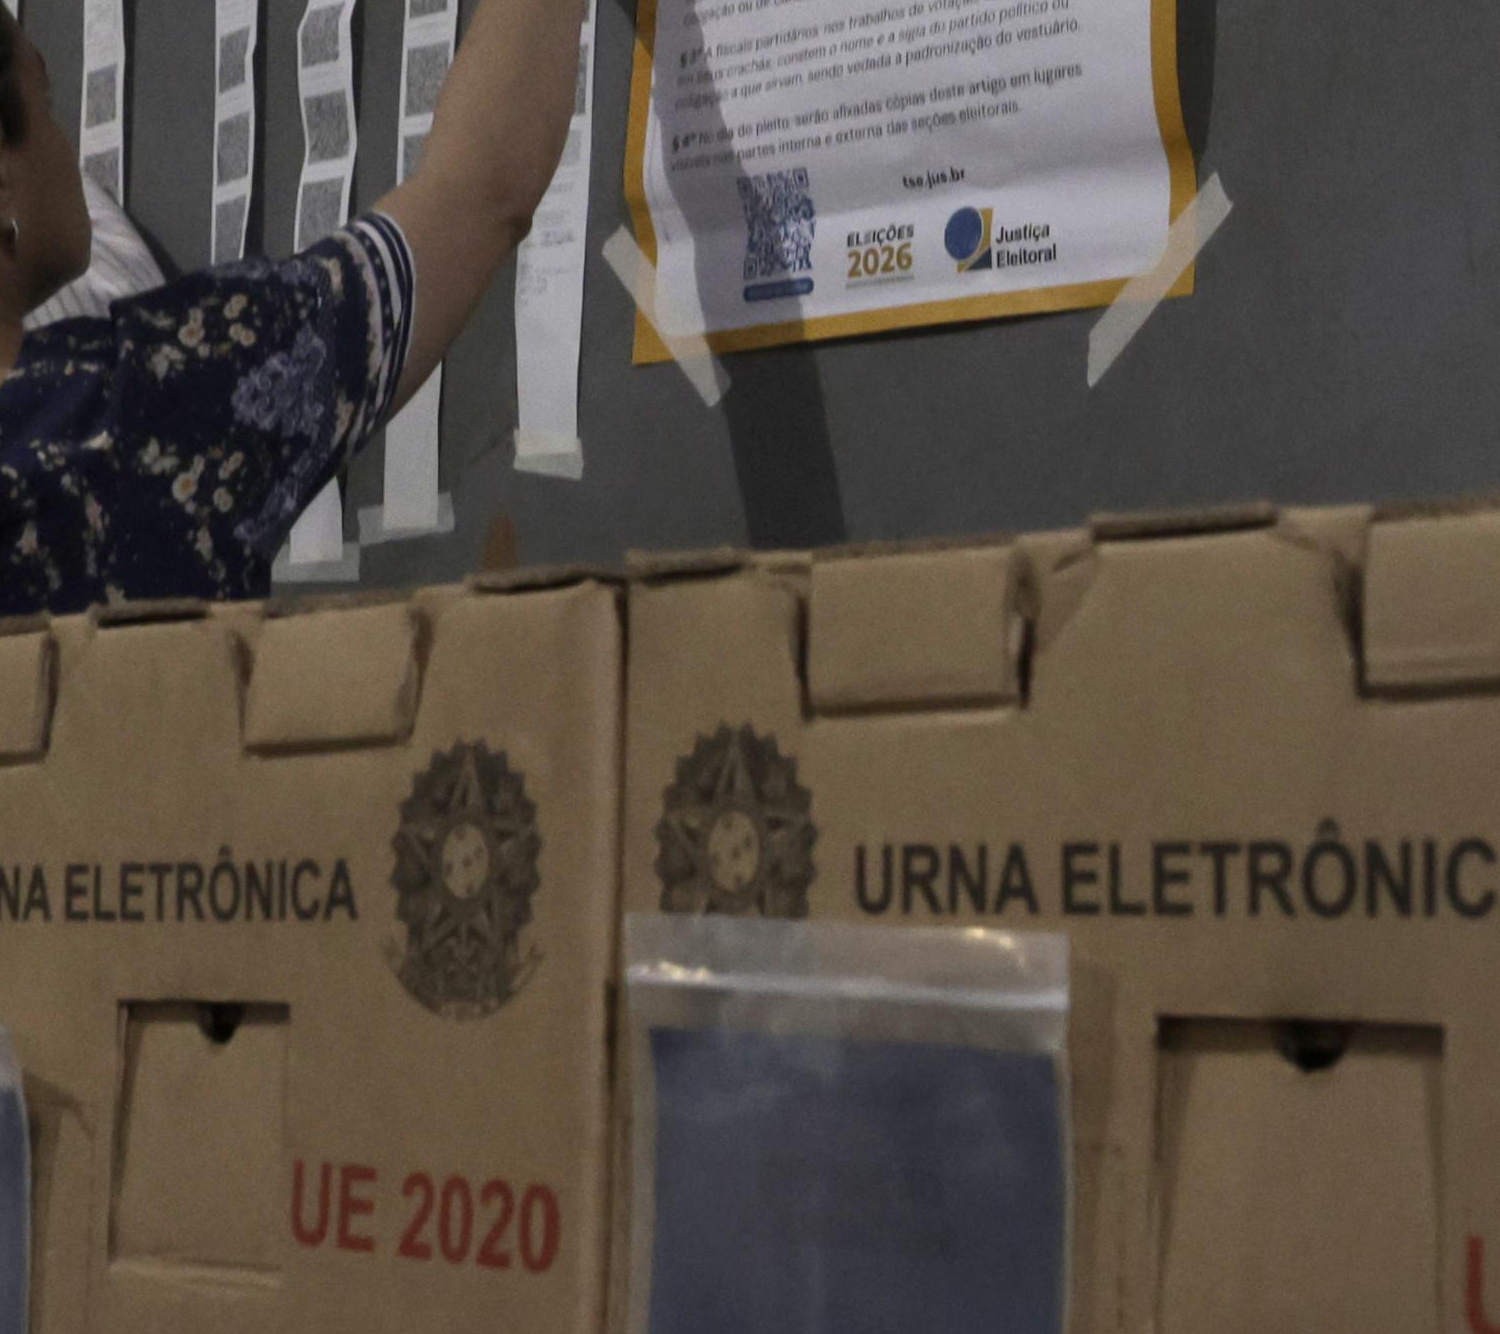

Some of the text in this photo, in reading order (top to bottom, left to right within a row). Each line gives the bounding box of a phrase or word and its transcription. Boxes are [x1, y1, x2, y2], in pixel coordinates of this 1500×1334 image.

[901, 167, 965, 189] tse.jus.br
[845, 223, 914, 249] ELEIÇÕES
[994, 223, 1051, 245] Justiça
[847, 242, 913, 278] 2026
[995, 243, 1057, 268] Eleitoral
[64, 849, 356, 922] ELETRÔNICA
[854, 842, 1038, 914] URNA
[290, 1161, 560, 1272] UE 2020
